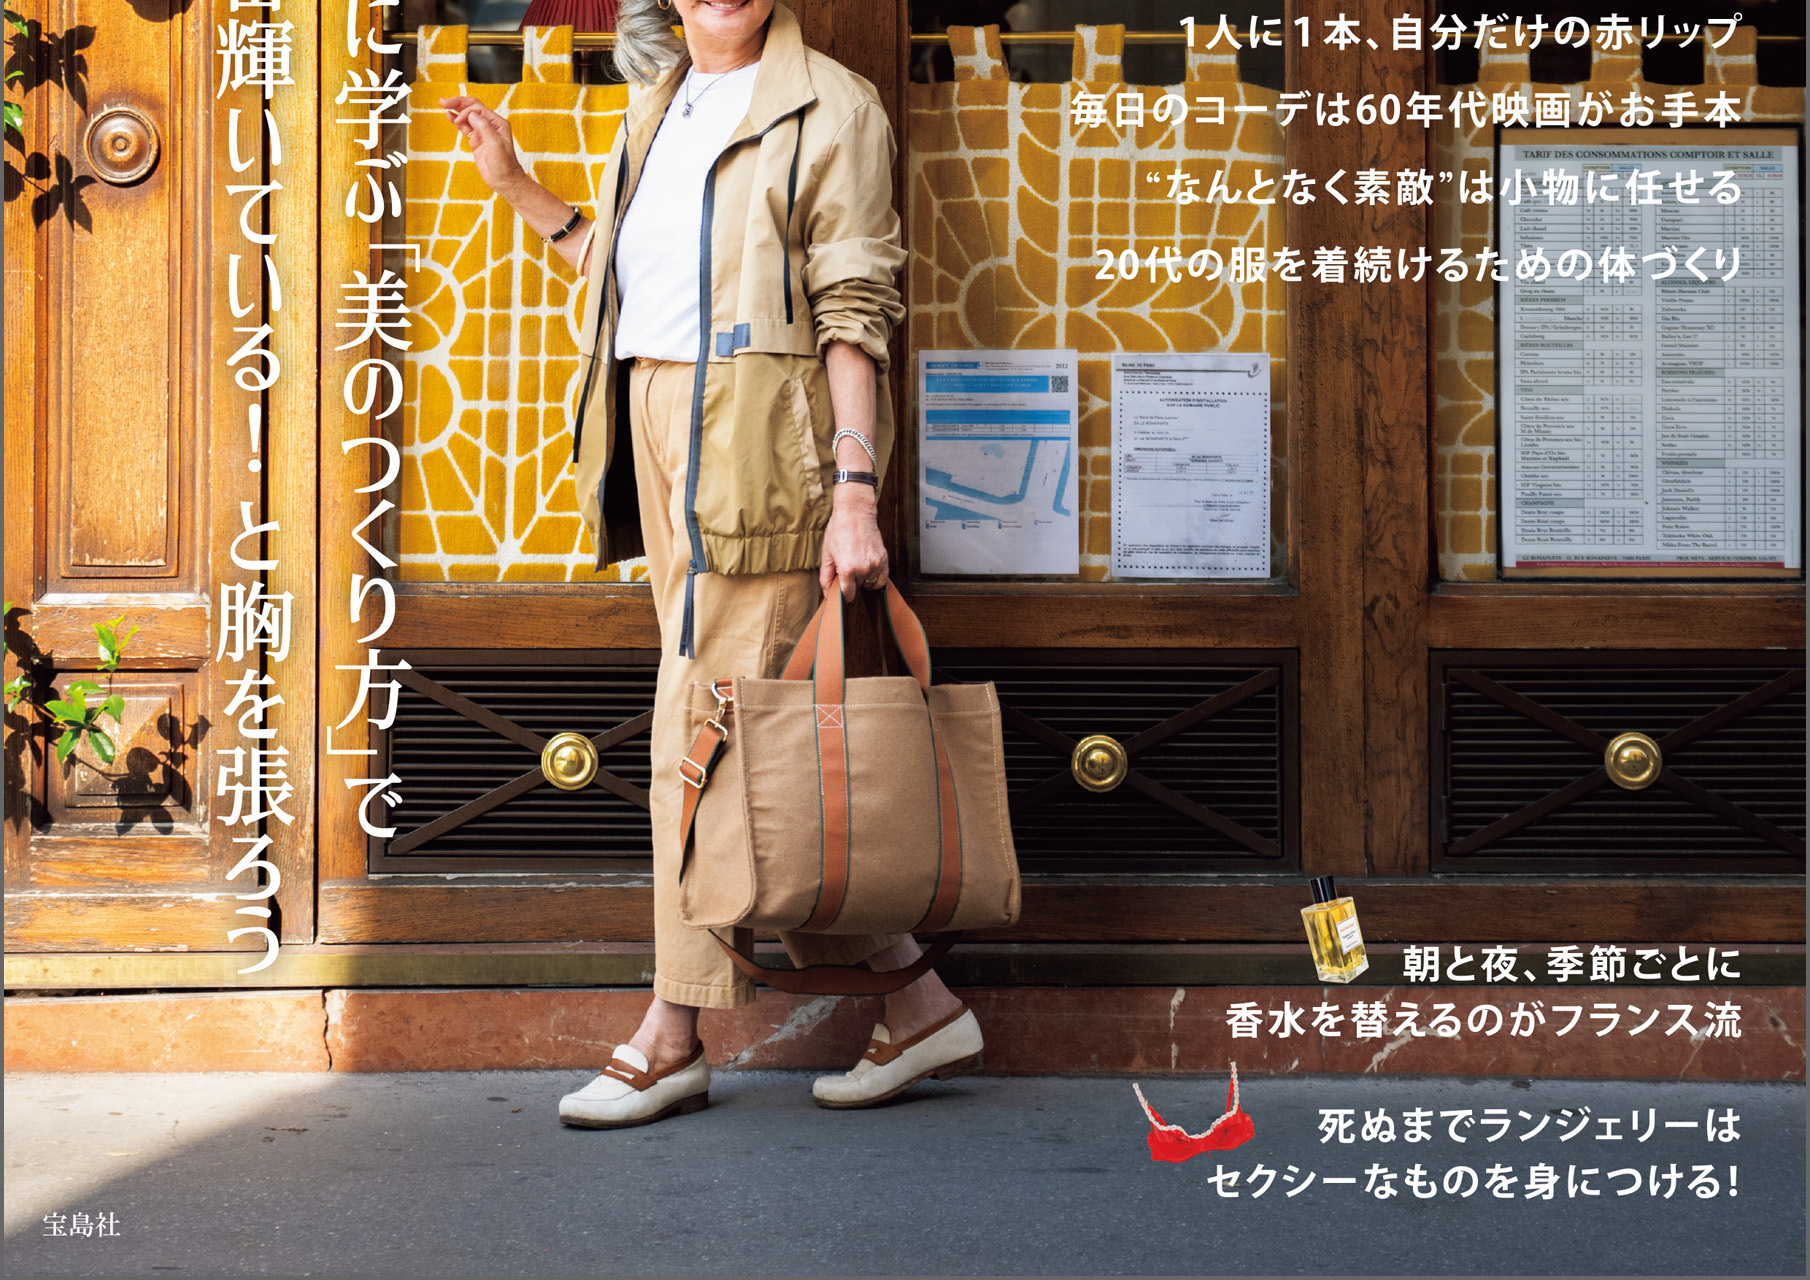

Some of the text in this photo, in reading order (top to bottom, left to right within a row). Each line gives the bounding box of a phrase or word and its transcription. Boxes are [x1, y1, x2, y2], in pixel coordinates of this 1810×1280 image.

[1523, 150, 1775, 159] TARIF DES CONSOMMATIONS COMPTOIR ET SALLE
